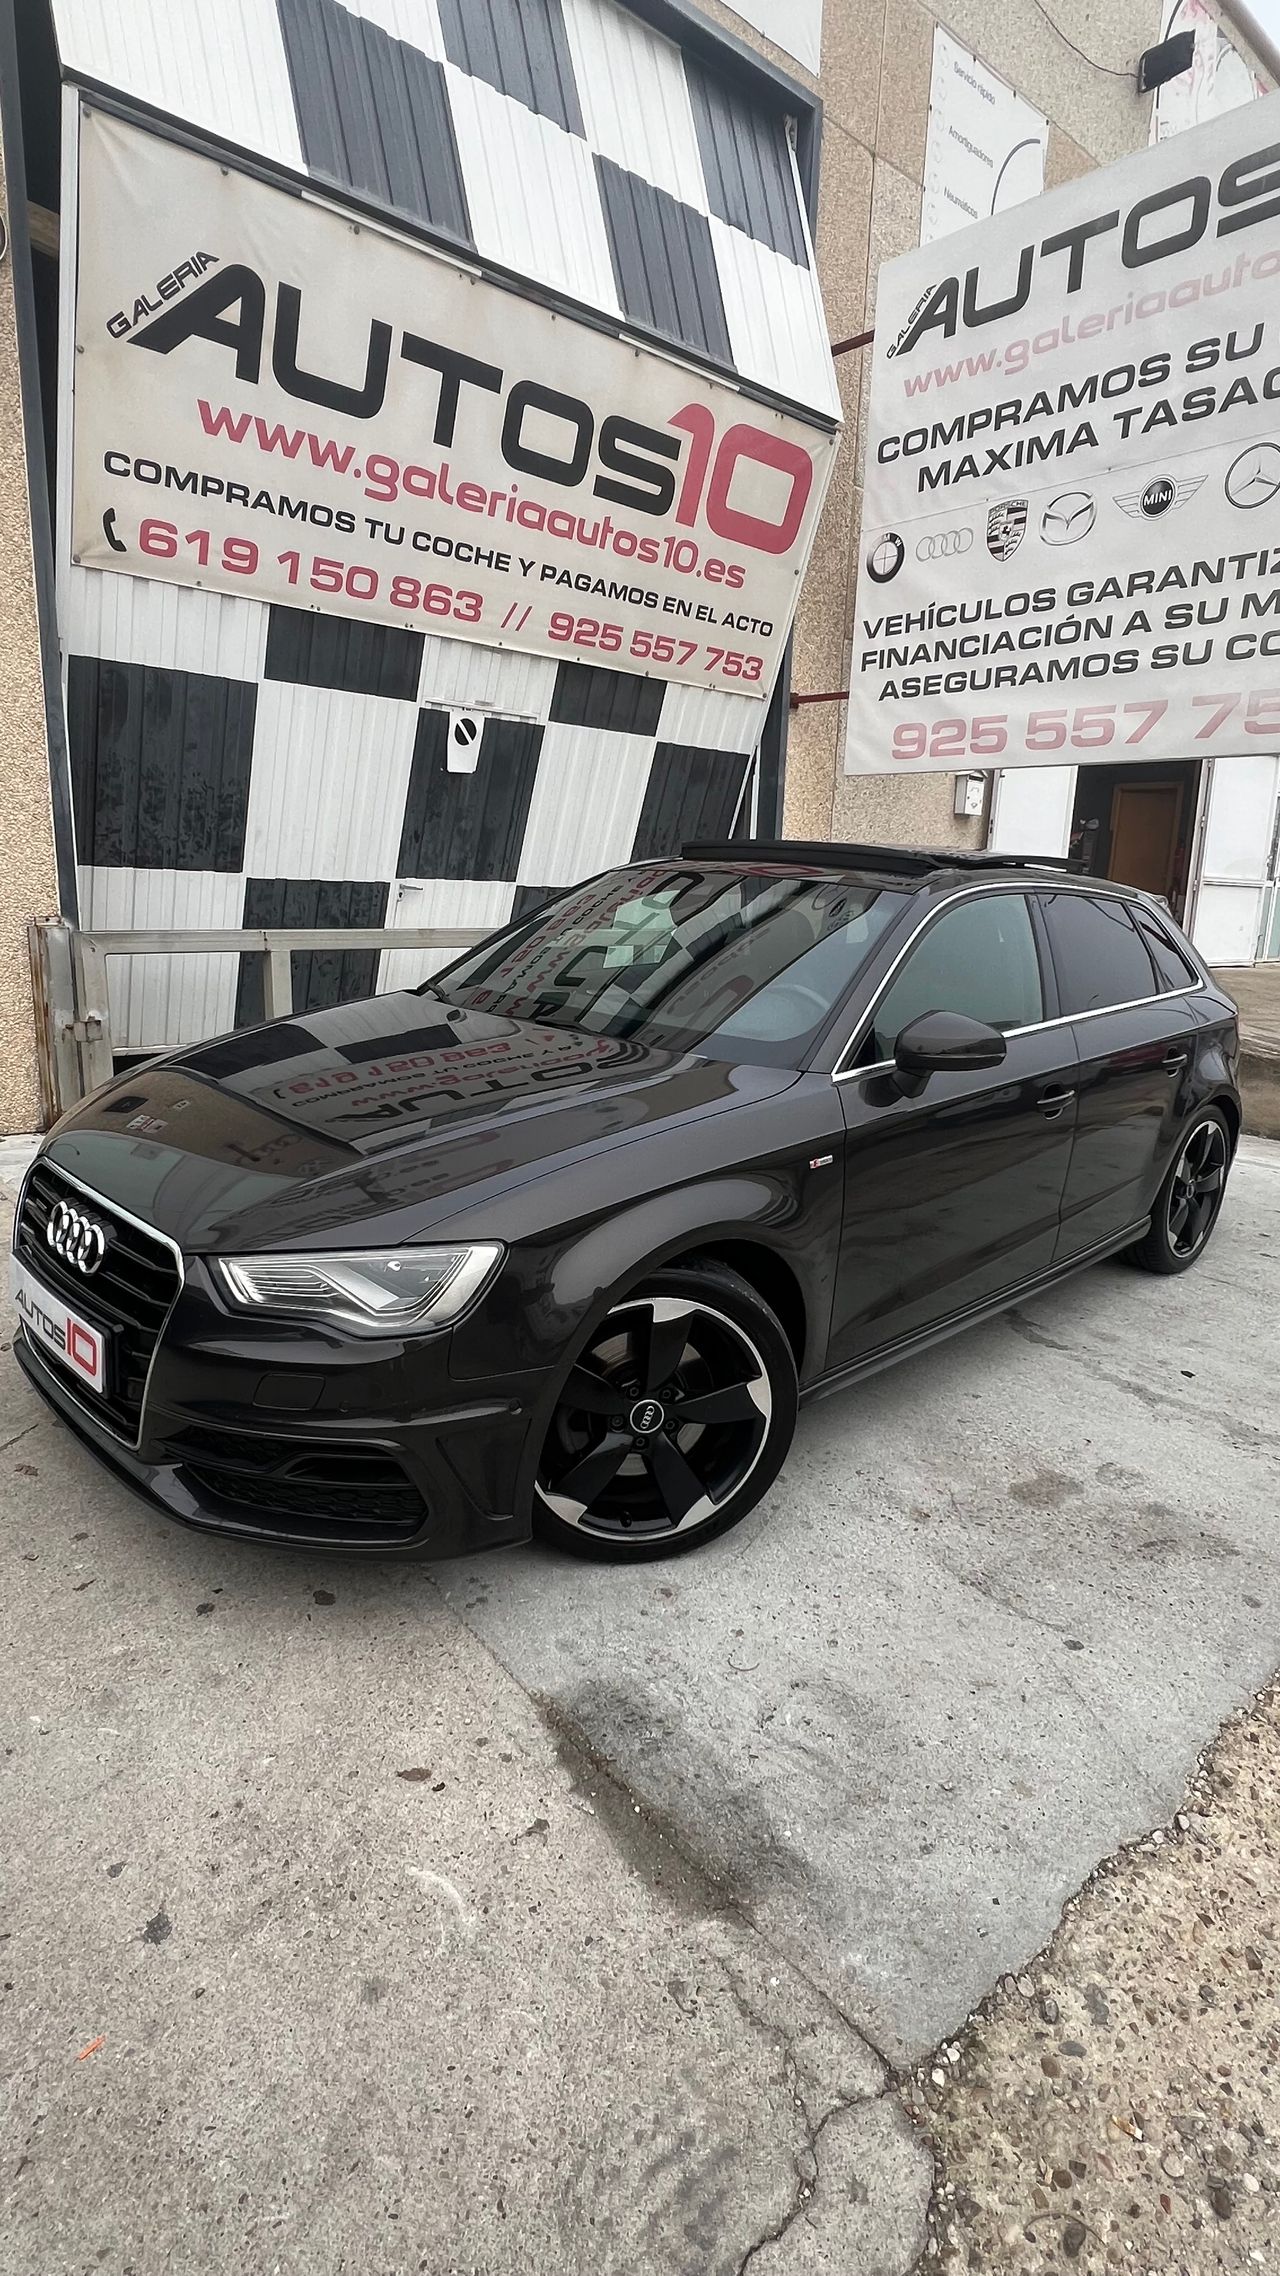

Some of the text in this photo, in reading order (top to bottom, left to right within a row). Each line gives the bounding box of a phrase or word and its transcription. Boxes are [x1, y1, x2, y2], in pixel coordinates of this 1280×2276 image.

[953, 61, 977, 90] Servicio
[949, 125, 994, 169] Amortiguadores
[105, 251, 219, 339] GALERIA
[886, 284, 937, 359] GALERIA
[126, 263, 813, 555] AUTOS10
[877, 322, 1265, 464] COMPRAMOS SU
[197, 399, 747, 589] www.galeriaautos10.es
[917, 421, 1100, 493] MAXIMA
[1143, 489, 1173, 507] MINI
[103, 449, 774, 638] COMPRAMOS TU COCHE Y PAGAMOS EN EL ACTO
[138, 517, 261, 575] 619
[277, 549, 380, 601] 150
[389, 575, 484, 623] 863
[547, 611, 625, 652] 925
[629, 630, 699, 667] 557
[703, 646, 764, 682] 753
[861, 613, 1114, 672] FINANCIACIÓN
[1122, 610, 1153, 637] A
[1164, 597, 1229, 630] SU
[863, 587, 1056, 639] VEHÍCULOS
[878, 649, 1139, 702] ASEGURAMOS
[1150, 638, 1214, 670] SU
[891, 714, 1008, 760] 925
[1025, 700, 1169, 752] 557
[15, 1289, 97, 1377] AUTOS10
